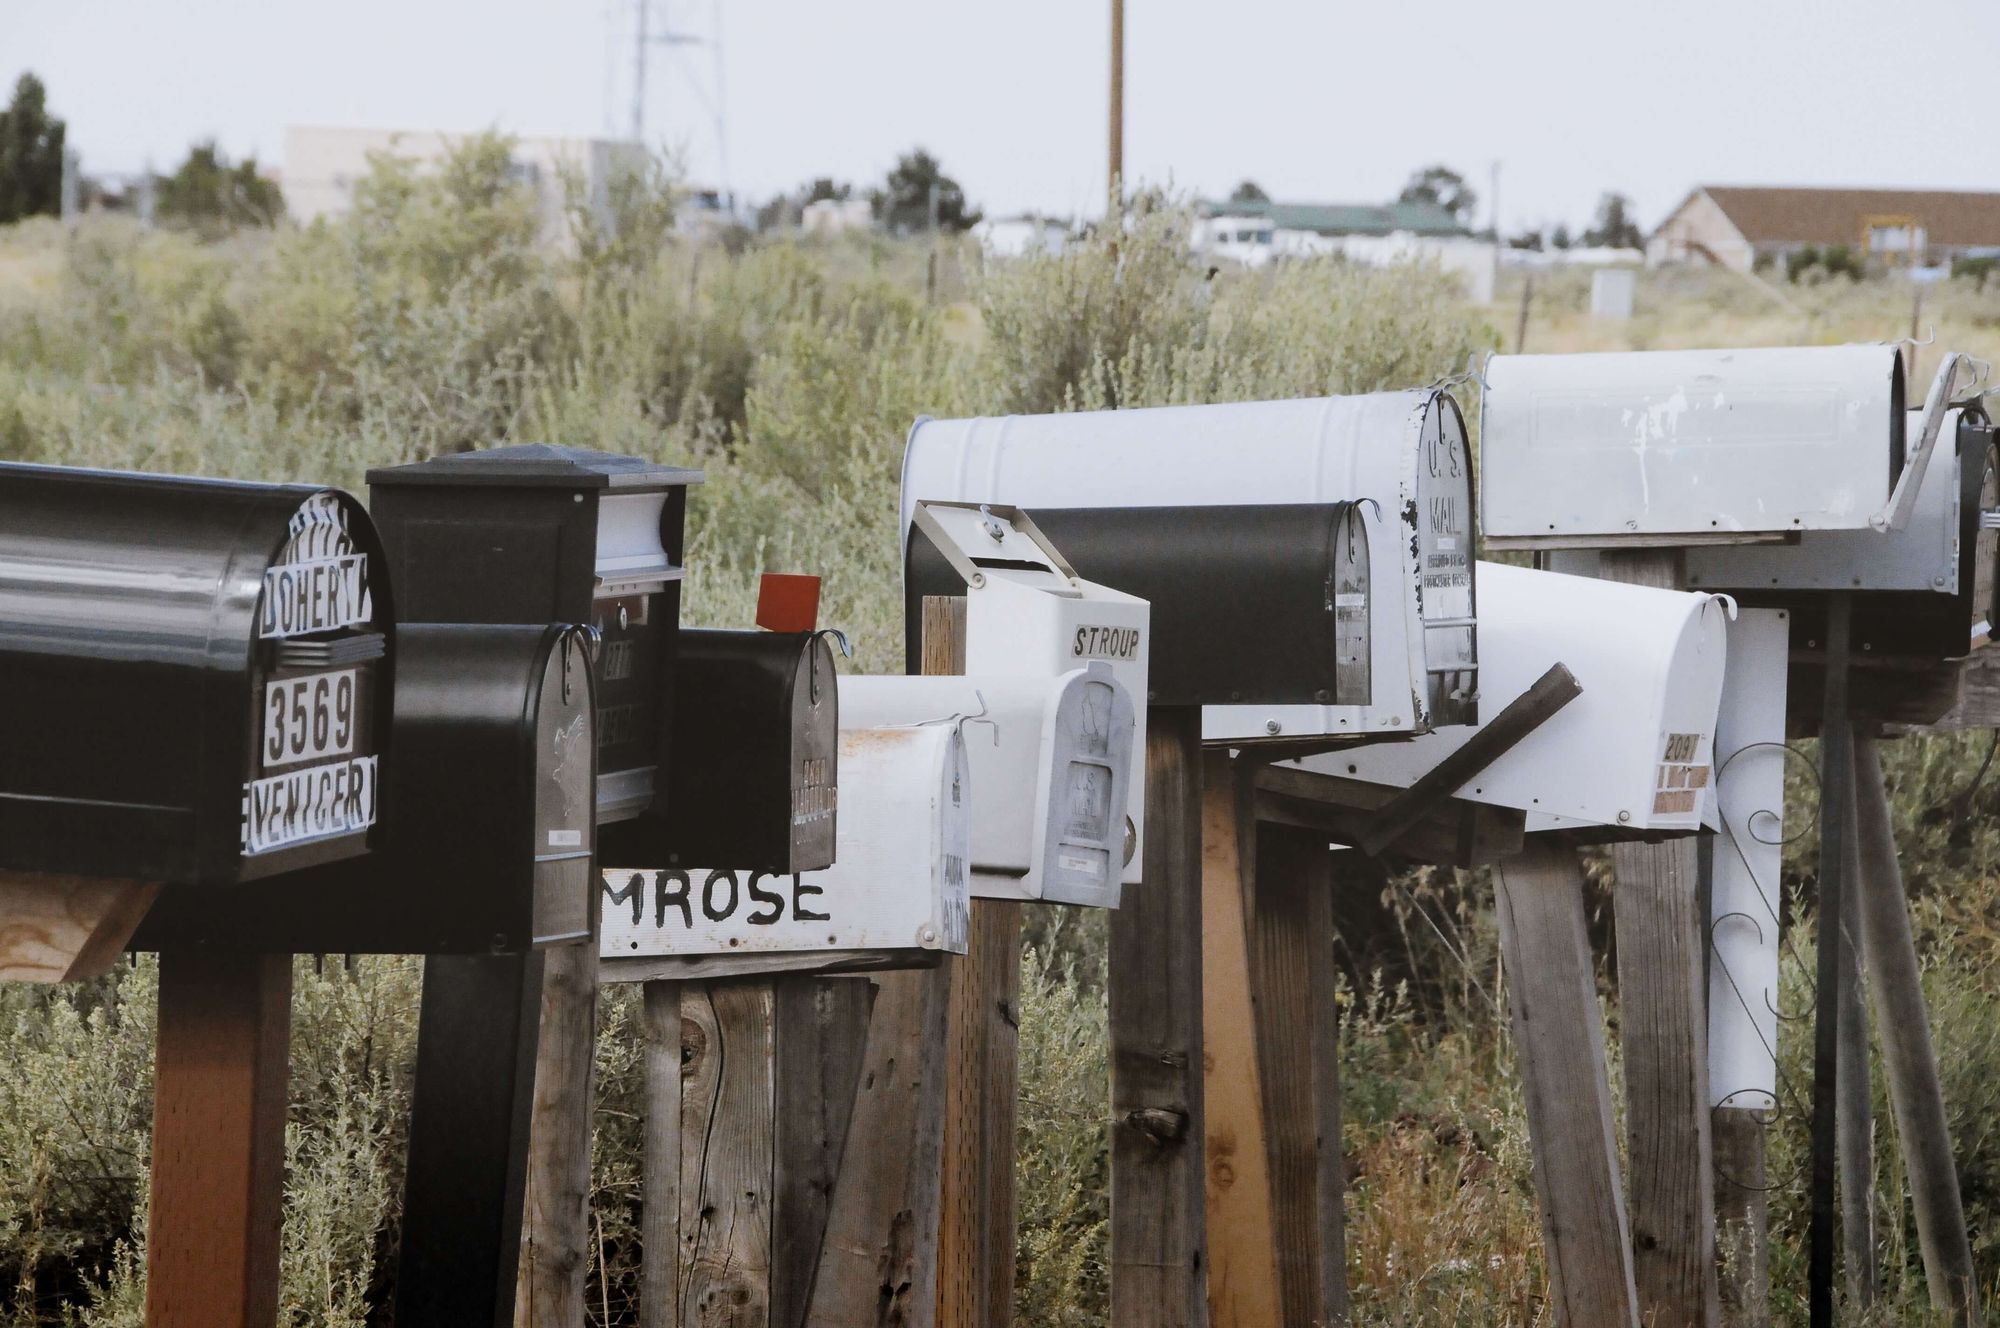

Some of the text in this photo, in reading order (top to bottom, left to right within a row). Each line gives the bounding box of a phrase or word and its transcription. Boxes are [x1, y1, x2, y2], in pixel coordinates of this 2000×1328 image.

[1429, 496, 1462, 535] MAIL
[1074, 627, 1139, 657] STROUP
[268, 674, 353, 761] 3569
